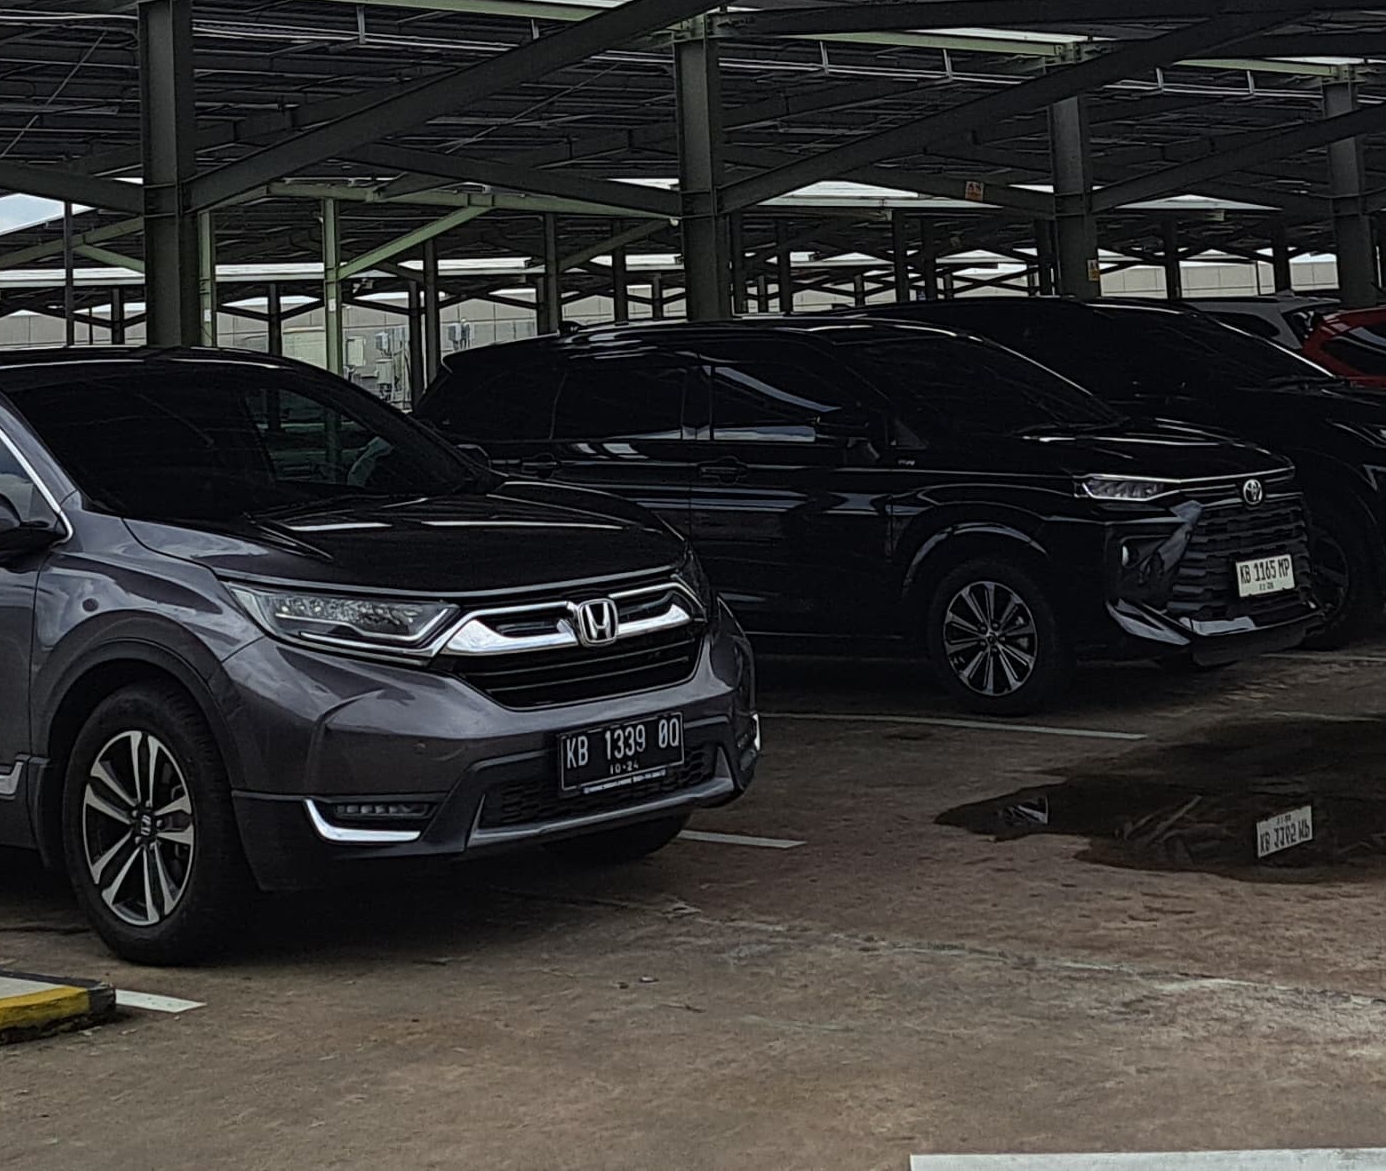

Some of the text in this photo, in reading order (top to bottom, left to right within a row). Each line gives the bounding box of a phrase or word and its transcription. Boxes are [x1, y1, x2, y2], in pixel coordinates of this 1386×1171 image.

[1240, 565, 1252, 584] KB
[1253, 560, 1276, 582] 1165
[567, 736, 588, 769] KB
[605, 724, 646, 760] 1339
